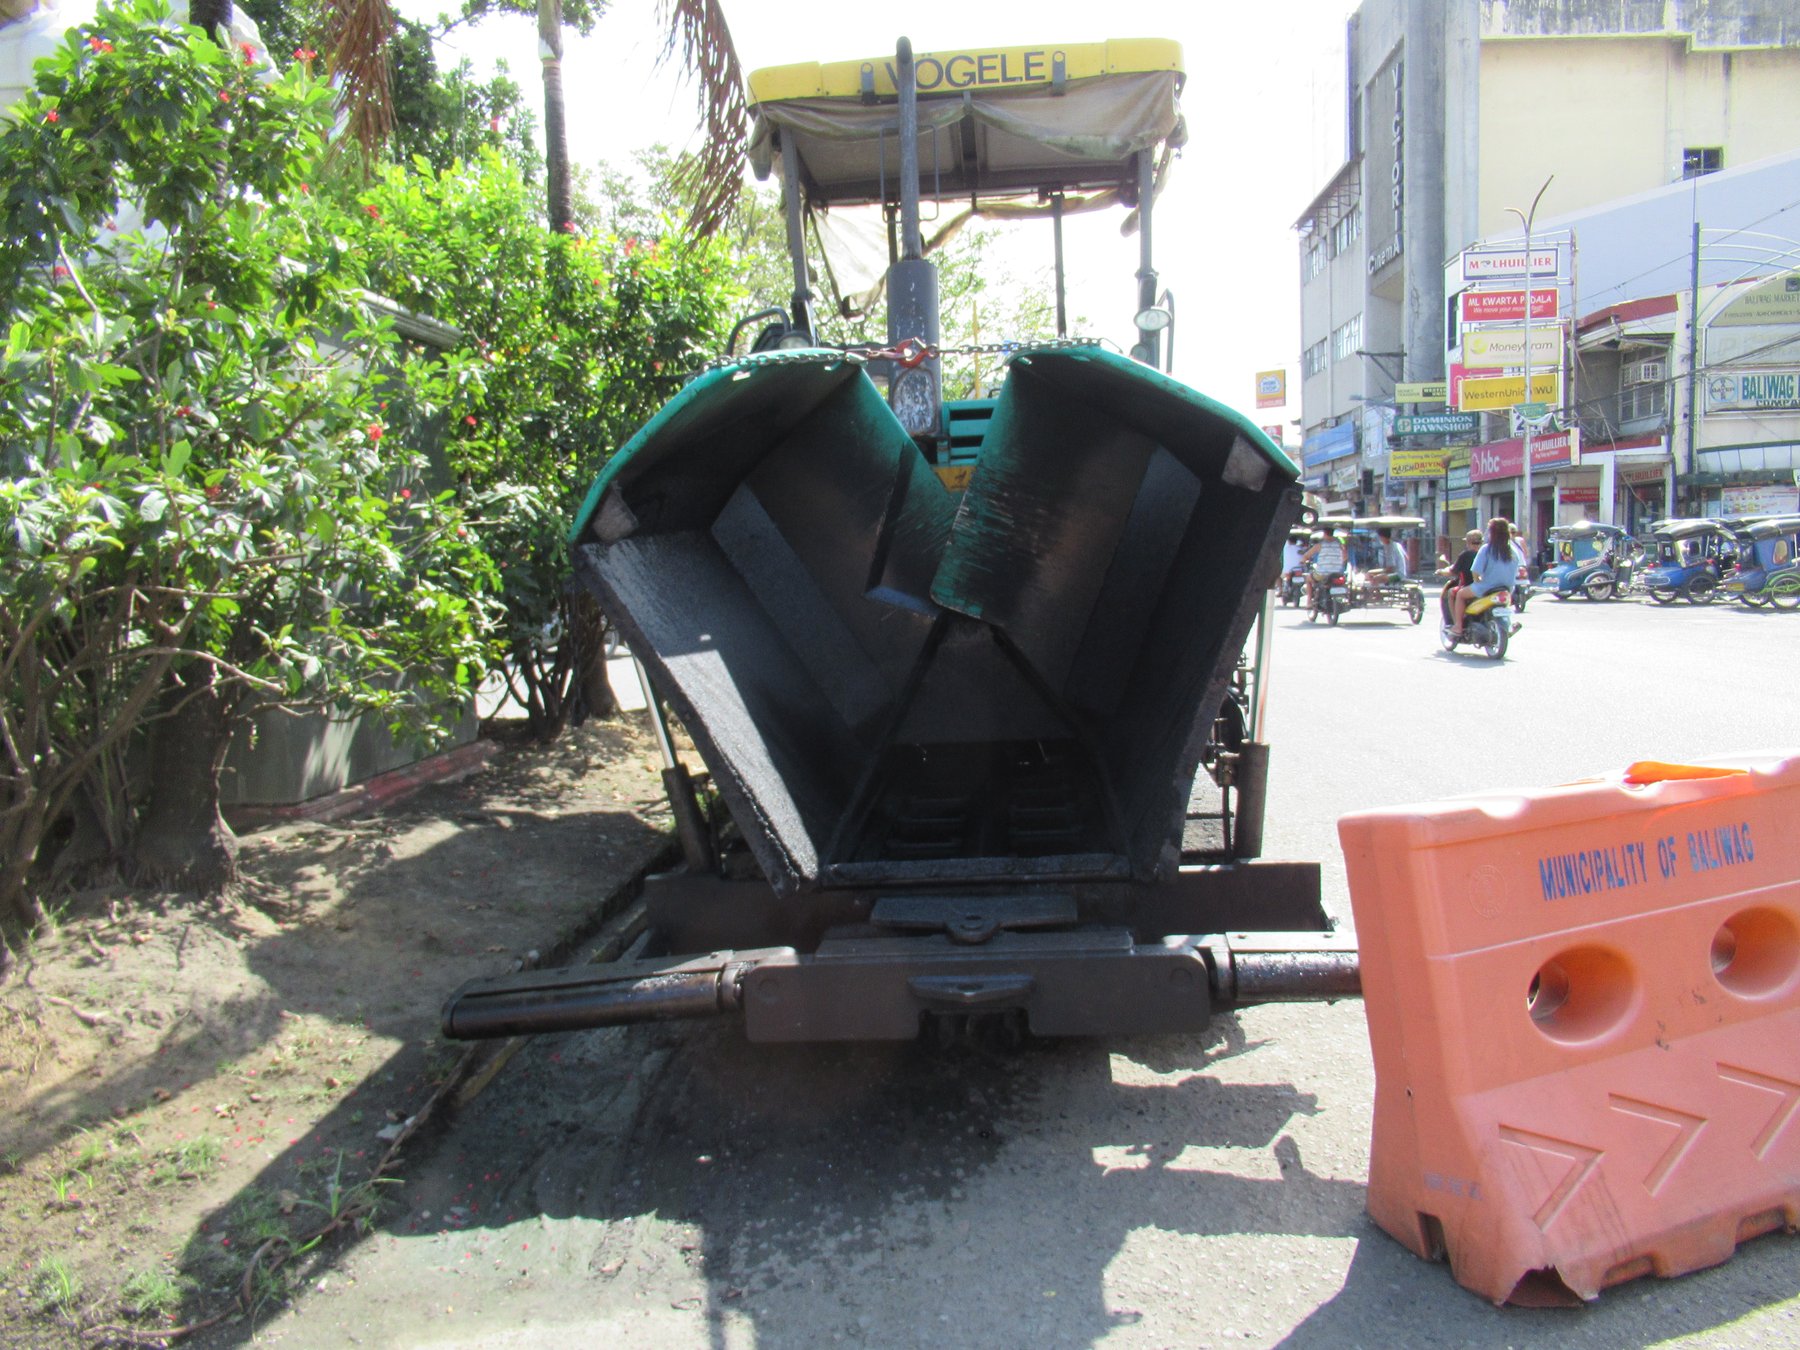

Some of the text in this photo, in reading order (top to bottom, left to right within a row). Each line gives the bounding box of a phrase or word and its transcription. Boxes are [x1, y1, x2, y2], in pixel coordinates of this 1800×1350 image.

[1468, 295, 1552, 306] ML KWARTA PDALA
[1535, 386, 1553, 394] WU
[1742, 375, 1794, 400] BALIWAG
[1413, 415, 1473, 424] DOMINION
[1413, 423, 1473, 432] PAWNSHOP
[1481, 450, 1500, 474] hbc
[1539, 822, 1754, 901] MUNICIPALITY OF BALIWAG
